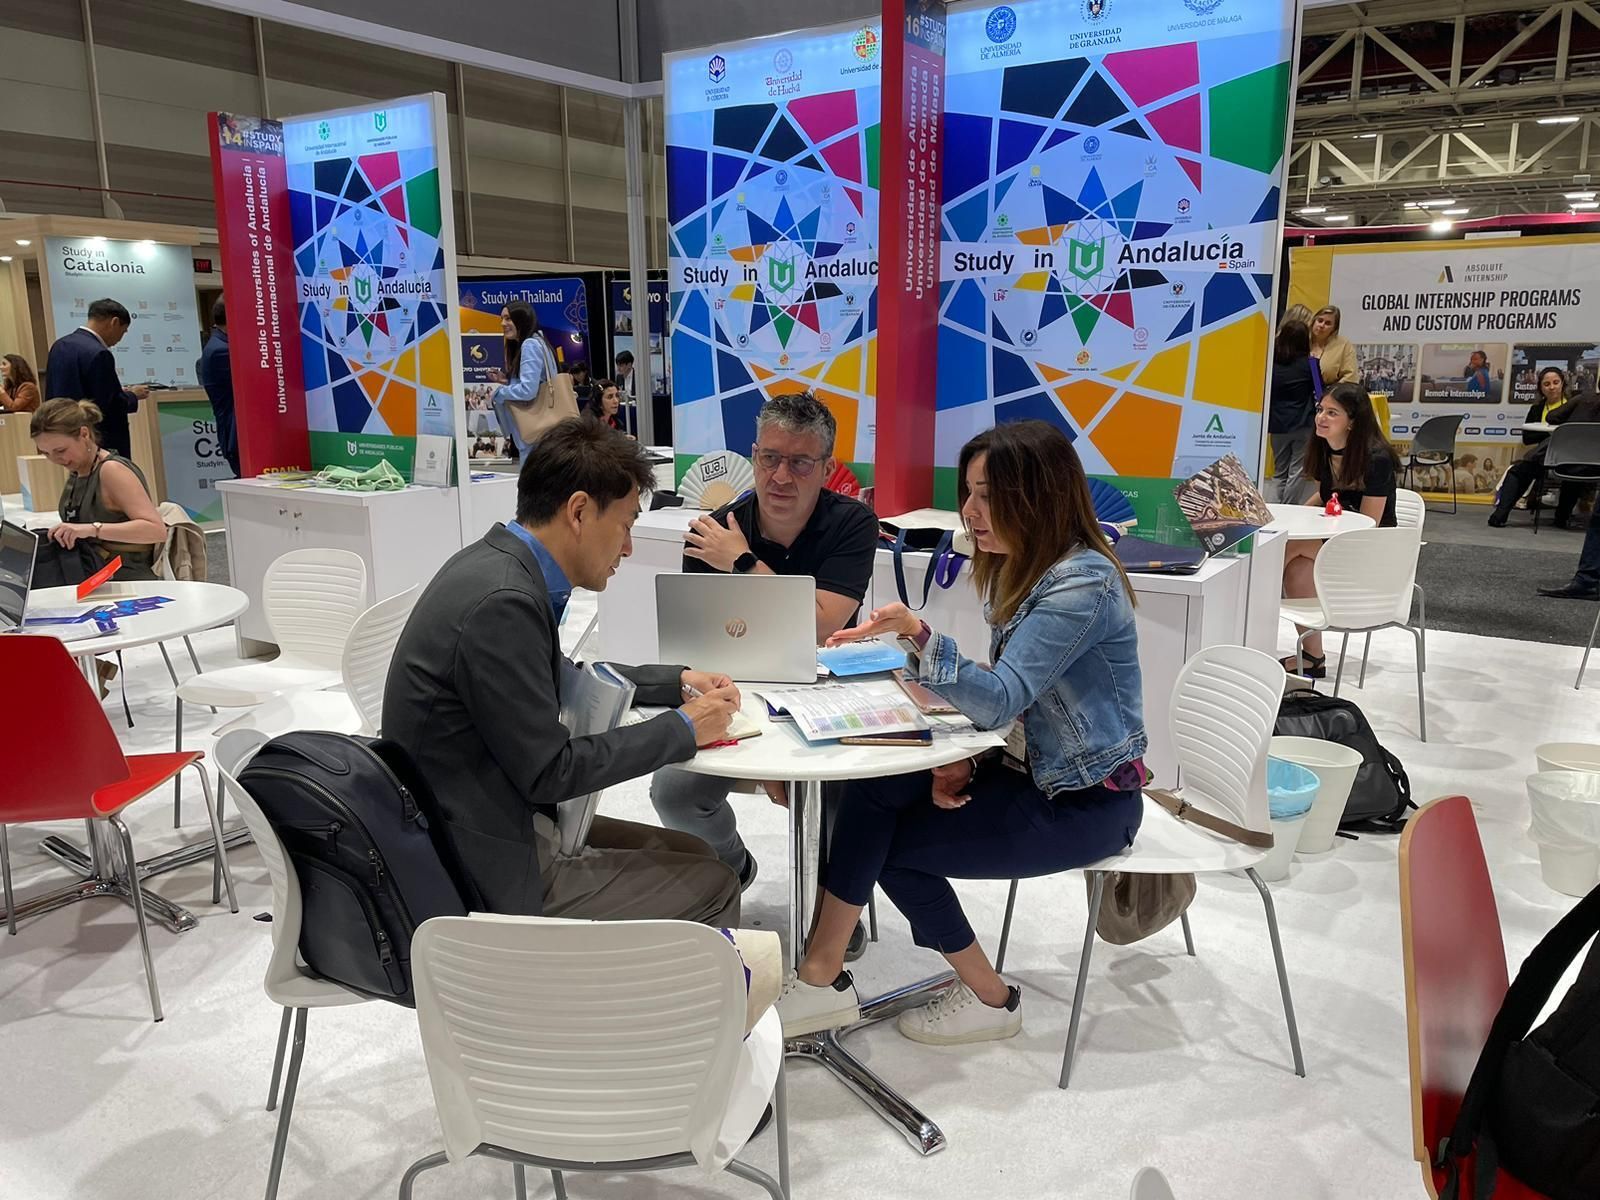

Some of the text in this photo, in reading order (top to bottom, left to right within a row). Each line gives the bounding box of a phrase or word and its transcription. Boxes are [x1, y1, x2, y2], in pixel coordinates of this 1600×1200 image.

[906, 14, 920, 36] 16
[920, 14, 946, 35] #STUDY
[1168, 20, 1206, 32] UNIVERSIDAD
[1070, 27, 1122, 41] UNIVERSIDAD
[1080, 36, 1121, 48] GRANADA
[980, 42, 1022, 54] UNIVERSIDAD
[765, 70, 802, 86] Universidad
[840, 64, 872, 76] Universidad
[222, 126, 242, 146] 14
[243, 130, 280, 142] #STUDY
[908, 148, 916, 172] de
[930, 150, 937, 173] de
[916, 70, 928, 300] Universidad de Granada
[249, 233, 258, 247] of
[906, 179, 916, 292] Universidad
[927, 179, 936, 289] Universidad
[264, 235, 272, 251] de
[62, 246, 104, 258] Study in
[954, 233, 1244, 275] Study in Andalucía
[63, 258, 146, 274] Catalonia
[684, 259, 878, 286] Study in Andaluc
[1229, 259, 1255, 270] Spain
[1466, 263, 1503, 272] ABSOLUTE
[1464, 273, 1508, 283] INTERNSHIP
[252, 251, 266, 325] Universities
[264, 255, 280, 337] Internacional
[303, 283, 330, 298] Study
[339, 282, 348, 295] in
[482, 289, 563, 304] Study in Thailand
[648, 292, 661, 302] YO
[1362, 288, 1581, 311] GLOBAL INTERNSHIP PROGRAMS
[1383, 312, 1557, 331] AND CUSTOM PROGRAMS
[258, 329, 269, 368] Public
[272, 341, 287, 414] Universidad
[1425, 389, 1485, 398] Remote Internships
[1514, 392, 1535, 402] Progra
[193, 420, 216, 434] Stu
